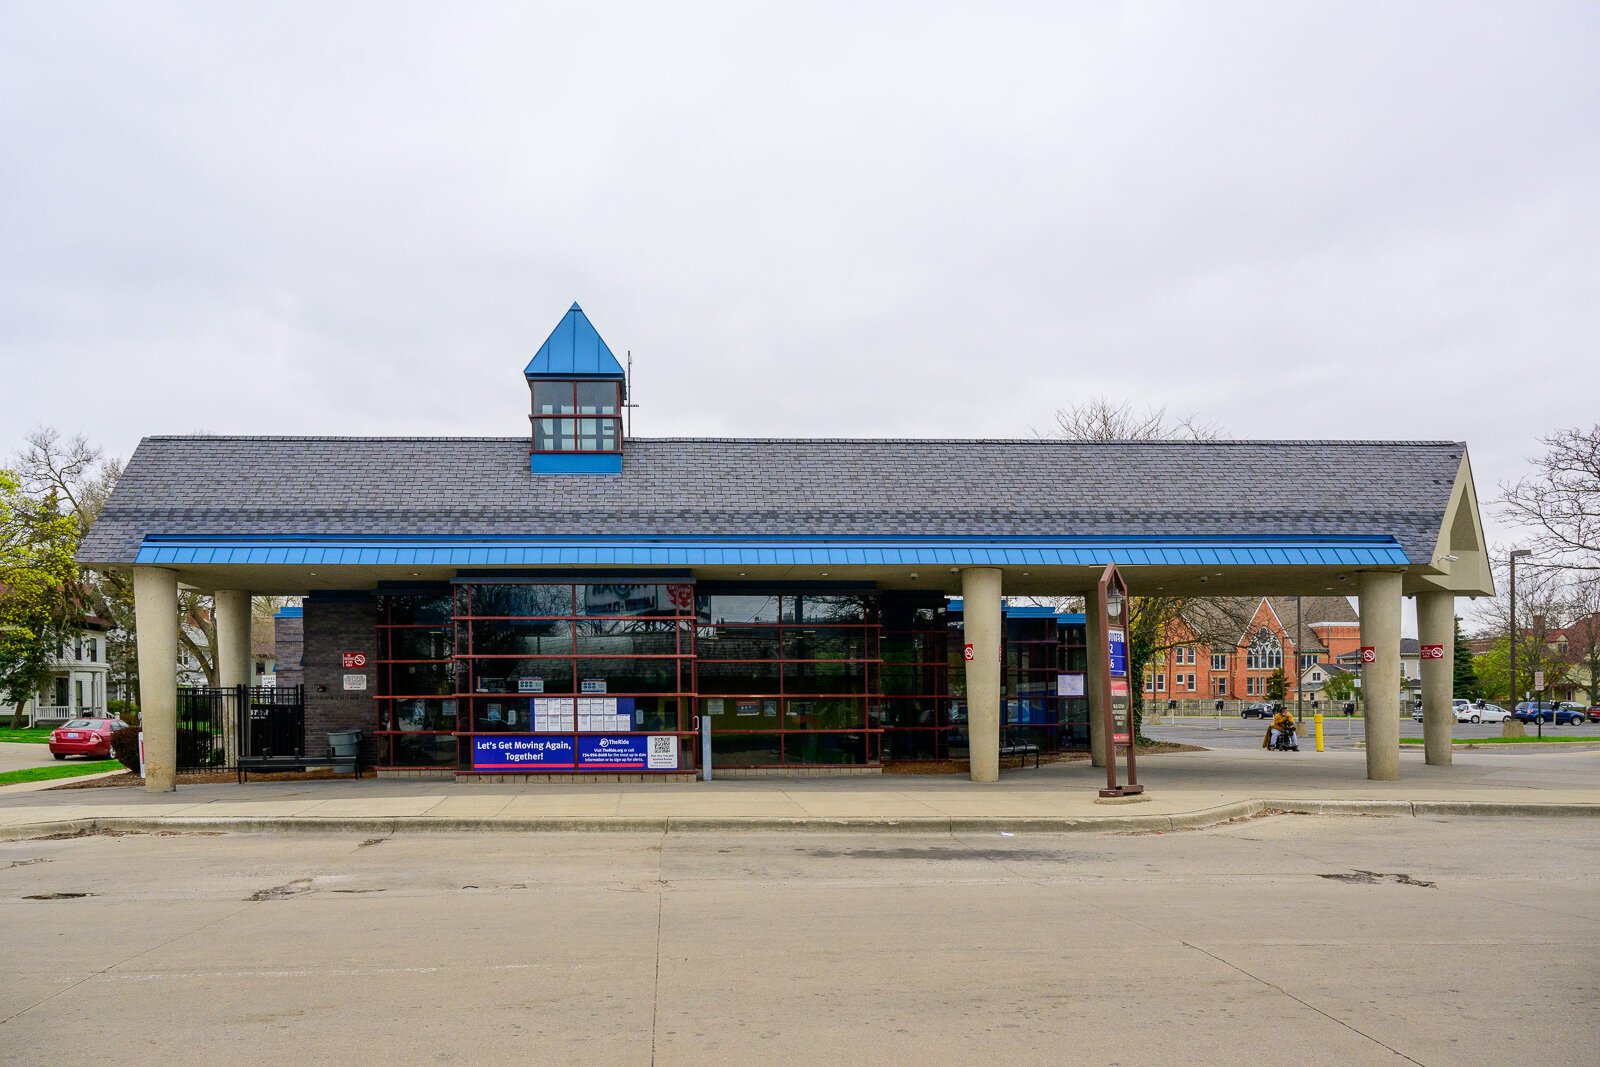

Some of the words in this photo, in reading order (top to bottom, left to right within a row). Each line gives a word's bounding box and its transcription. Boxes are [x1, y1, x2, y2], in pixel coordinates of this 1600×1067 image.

[498, 741, 512, 749] Get
[514, 741, 544, 750] Moving
[545, 741, 571, 750] Again,
[505, 752, 543, 762] Together!
